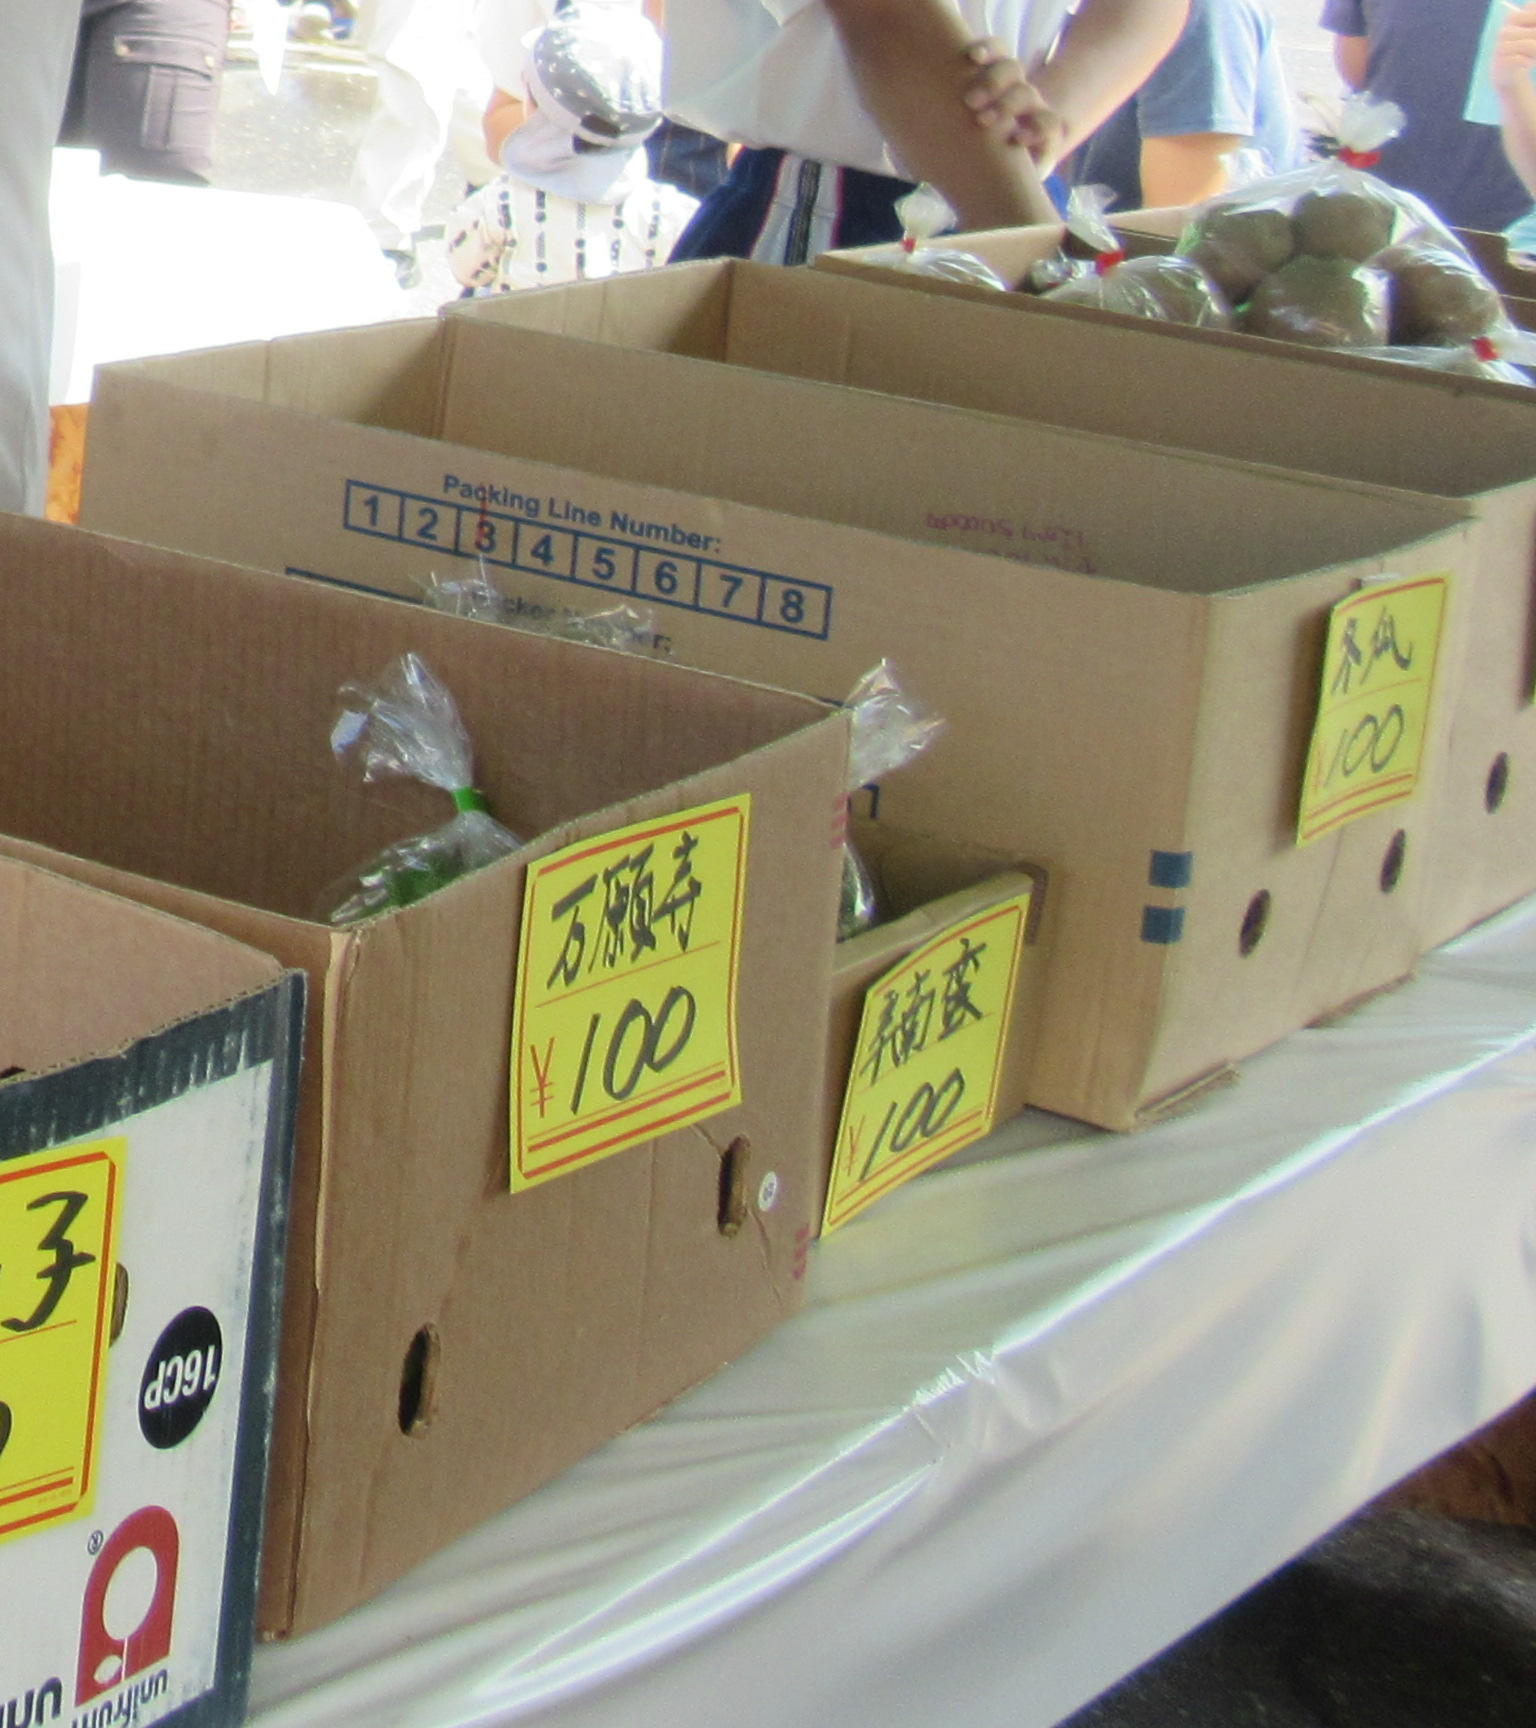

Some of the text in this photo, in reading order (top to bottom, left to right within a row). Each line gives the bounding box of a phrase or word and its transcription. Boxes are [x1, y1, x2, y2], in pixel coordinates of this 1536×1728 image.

[363, 495, 806, 624] 1 2 3 4 5 6 7 8
[442, 474, 722, 555] Packing Line Number:
[529, 985, 697, 1120] ¥100
[143, 1340, 221, 1414] 16CP
